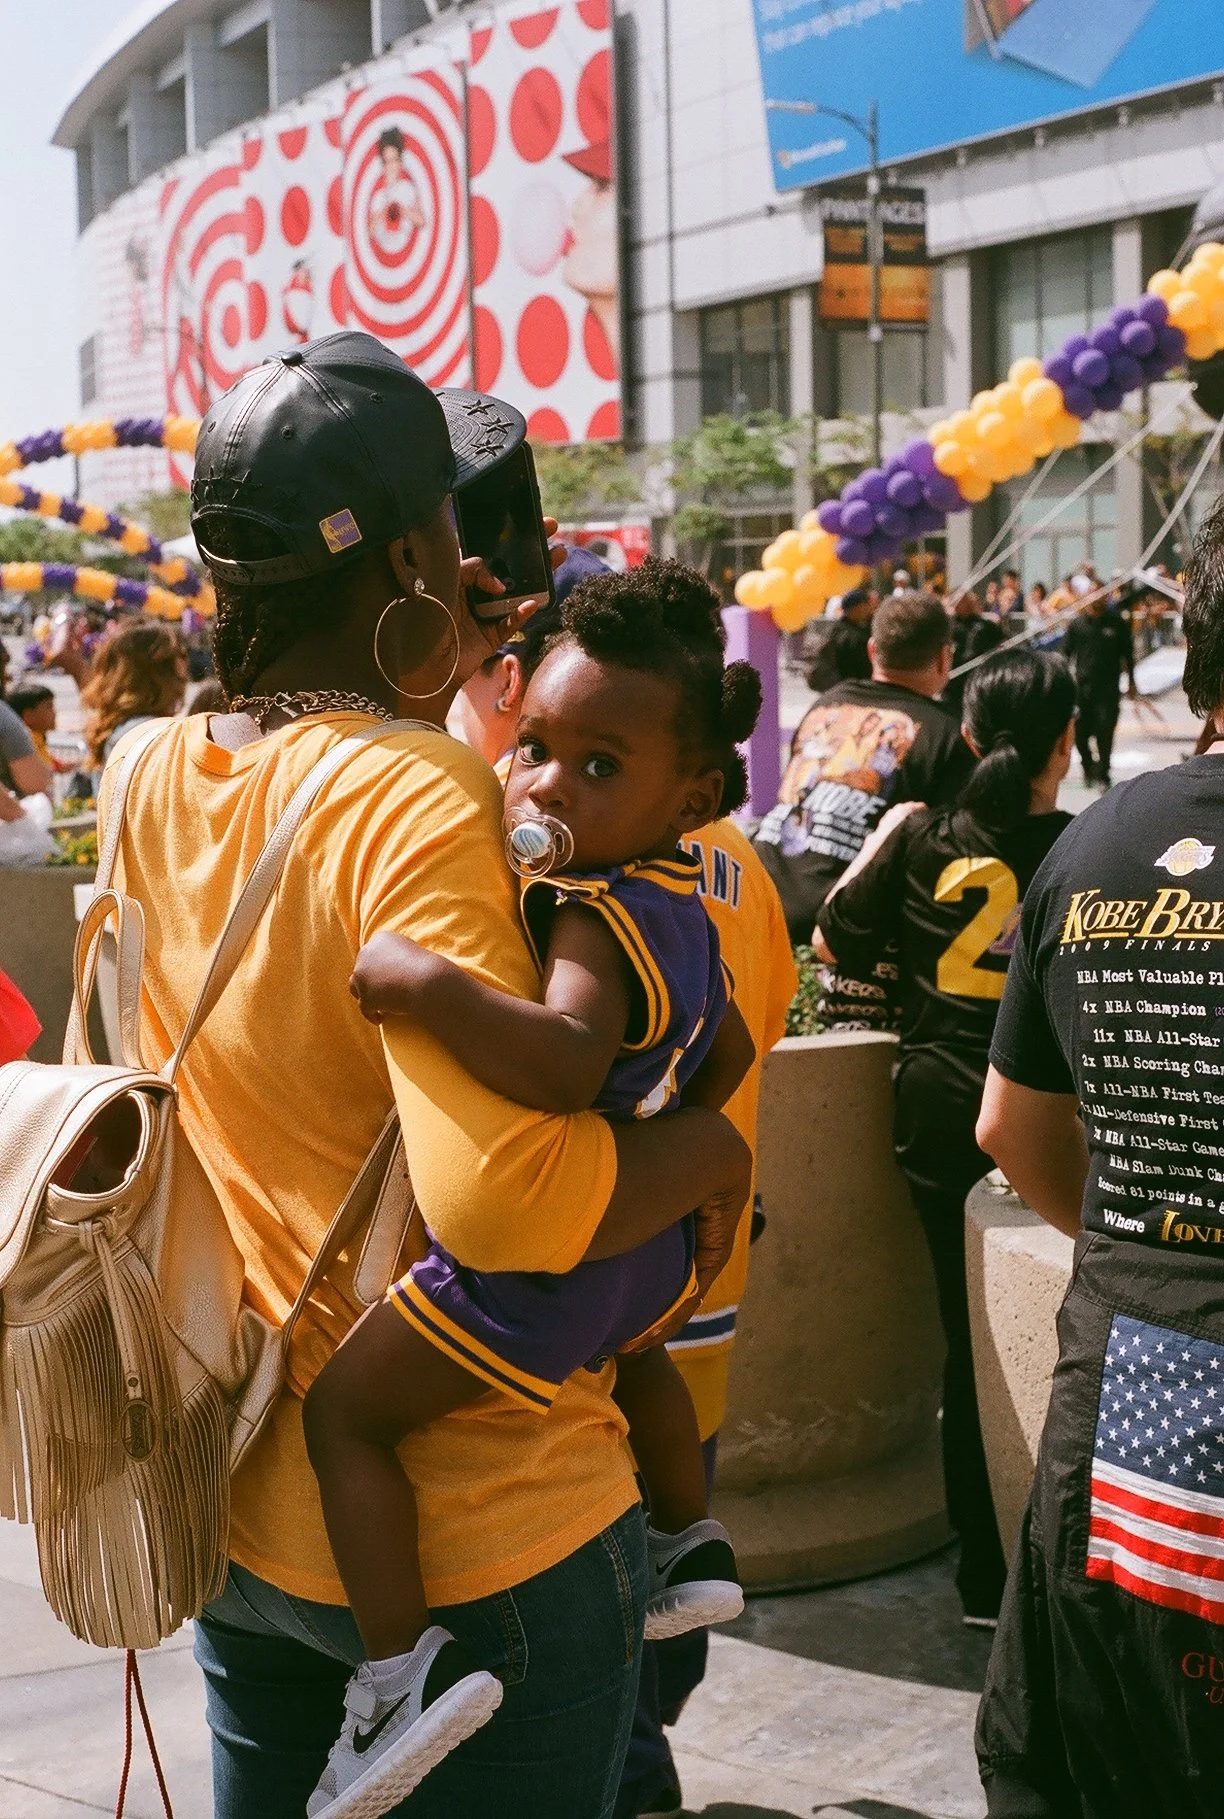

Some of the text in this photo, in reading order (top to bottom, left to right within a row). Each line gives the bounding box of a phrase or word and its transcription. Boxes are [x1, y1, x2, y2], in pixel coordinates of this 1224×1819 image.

[675, 838, 743, 912] ANT
[1059, 888, 1224, 944] KOBE BRY
[1124, 939, 1211, 952] FINALS
[1076, 970, 1099, 984] NBA
[1102, 969, 1134, 983] Most
[1138, 969, 1204, 985] Valuable
[1082, 1000, 1097, 1014] 4x
[1104, 1000, 1132, 1014] NBA
[1136, 1000, 1207, 1017] Champion
[1093, 1028, 1221, 1047] 11x NBA All-Star
[1082, 1053, 1097, 1068] 2x
[1102, 1055, 1130, 1068] NBA
[1133, 1056, 1191, 1078] Scoring
[1103, 1082, 1159, 1099] All-NBA
[1161, 1086, 1201, 1103] First
[1092, 1104, 1176, 1126] All-Defensive
[1178, 1113, 1219, 1131] First
[1104, 1129, 1126, 1147] NBA
[1130, 1134, 1188, 1153] All-Star
[1109, 1153, 1130, 1172] NBA
[1132, 1160, 1164, 1176] Slam
[1168, 1164, 1204, 1179] Dunk
[1097, 1176, 1127, 1197] Scored
[1130, 1187, 1145, 1198] 81
[1147, 1189, 1186, 1204] points
[1187, 1193, 1203, 1207] in
[1207, 1199, 1216, 1208] a
[1103, 1208, 1145, 1233] Where
